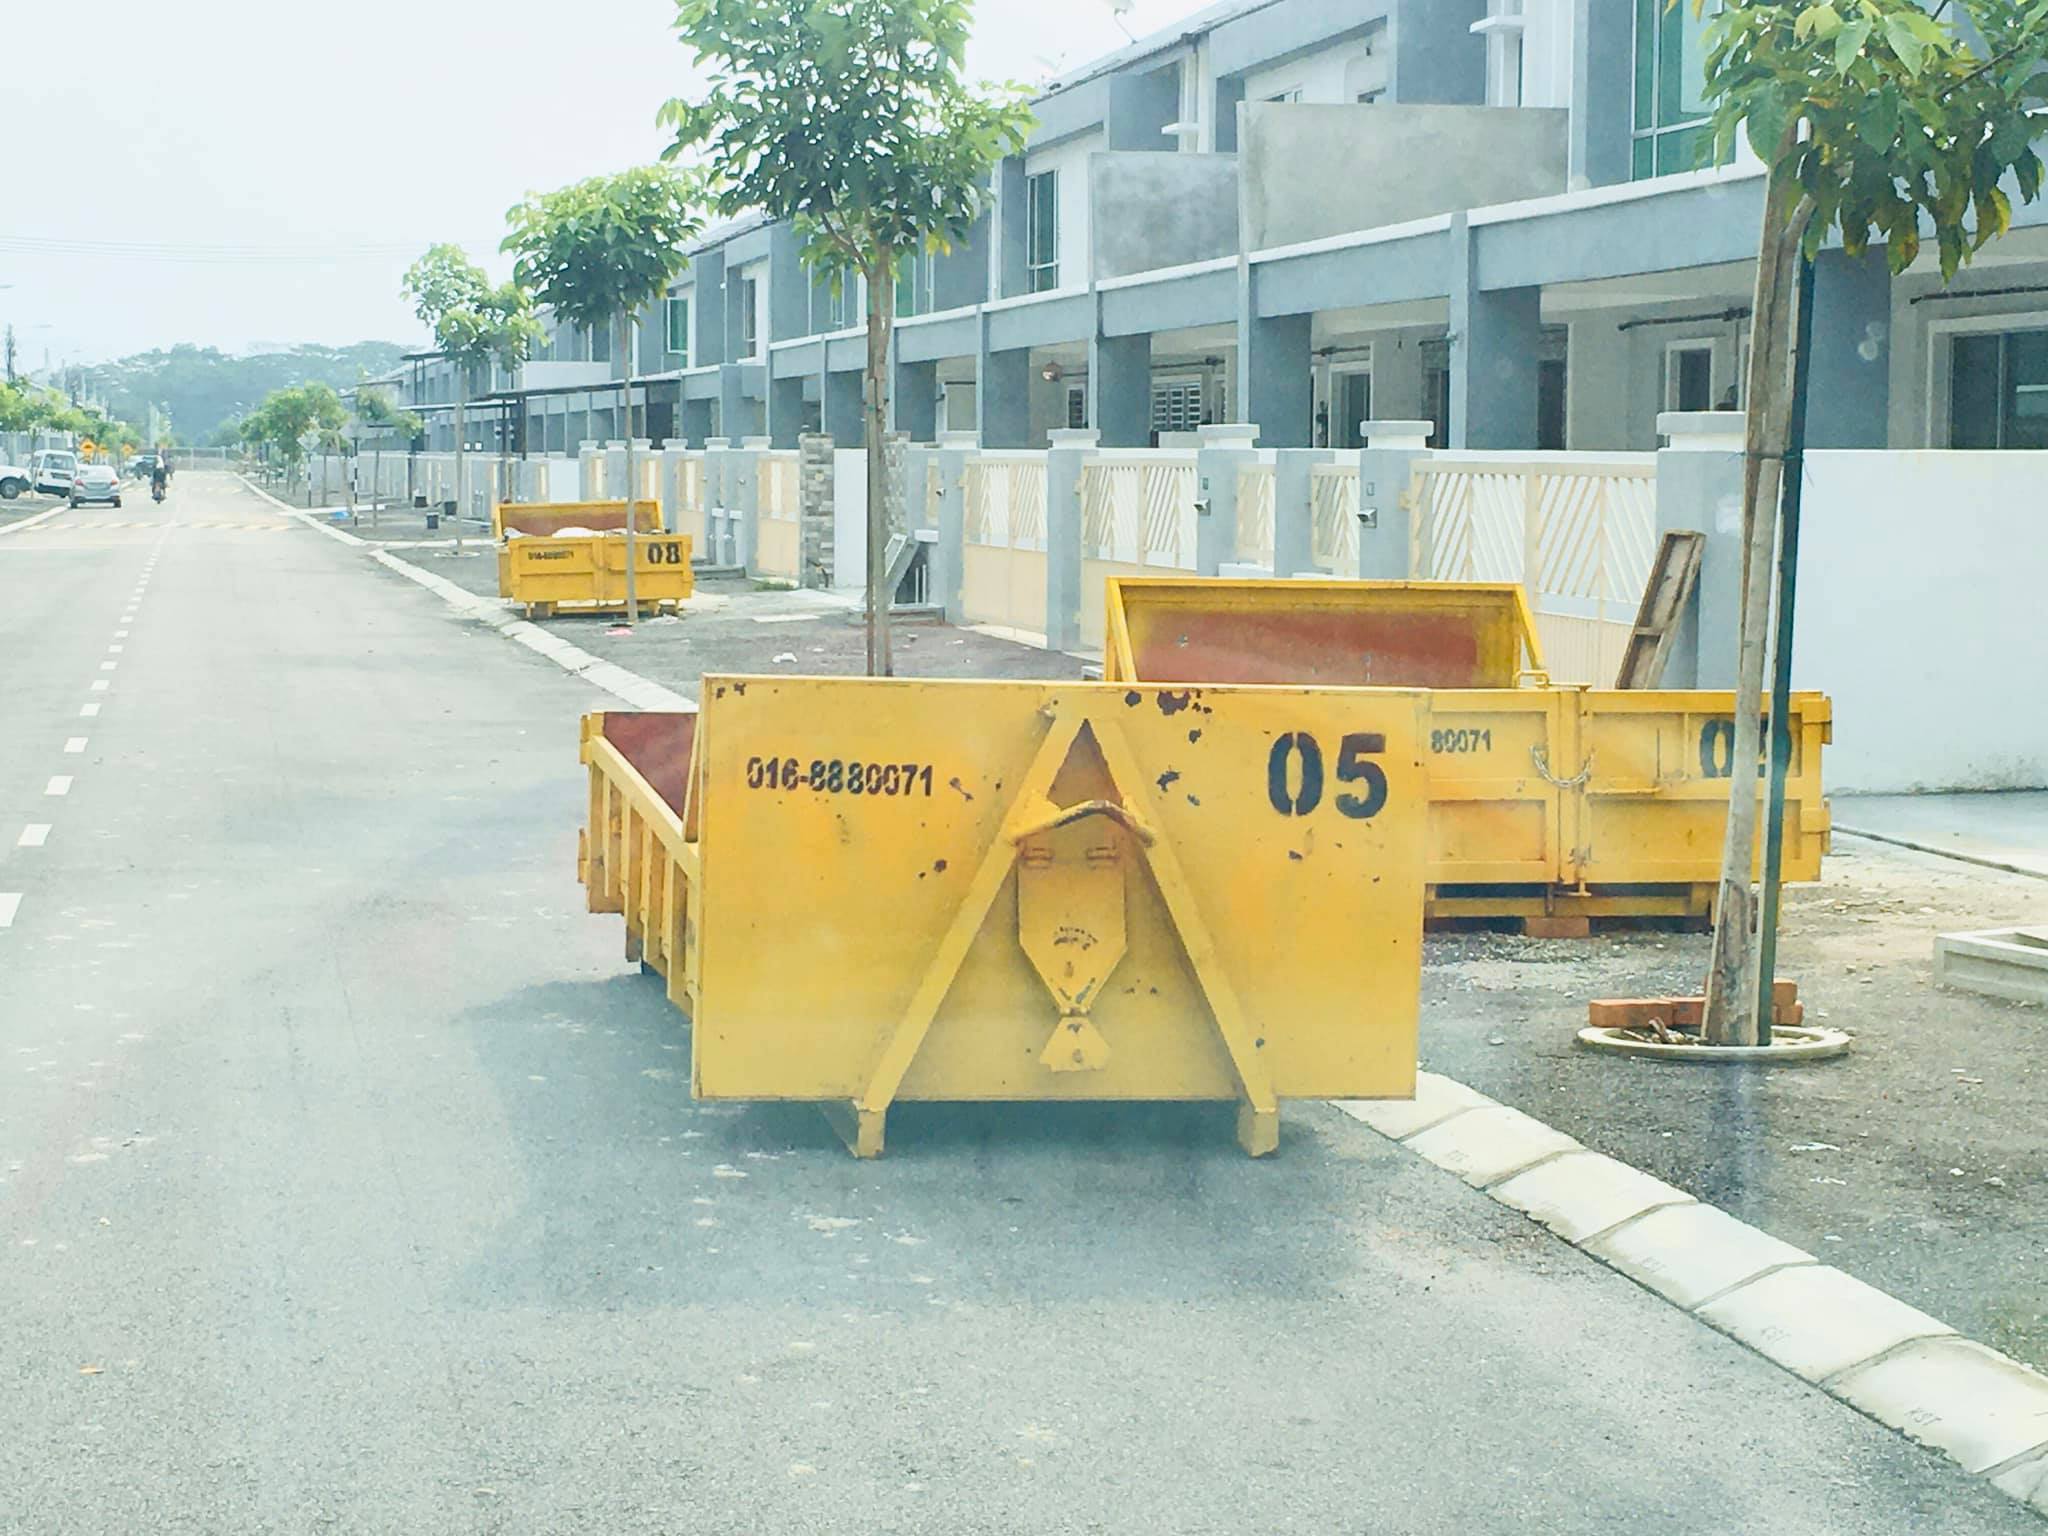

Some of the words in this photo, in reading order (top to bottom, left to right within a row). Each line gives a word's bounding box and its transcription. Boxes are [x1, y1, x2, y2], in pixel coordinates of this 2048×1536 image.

[647, 542, 681, 564] 08
[747, 756, 933, 797] 016-8880071
[1268, 731, 1388, 819] 05
